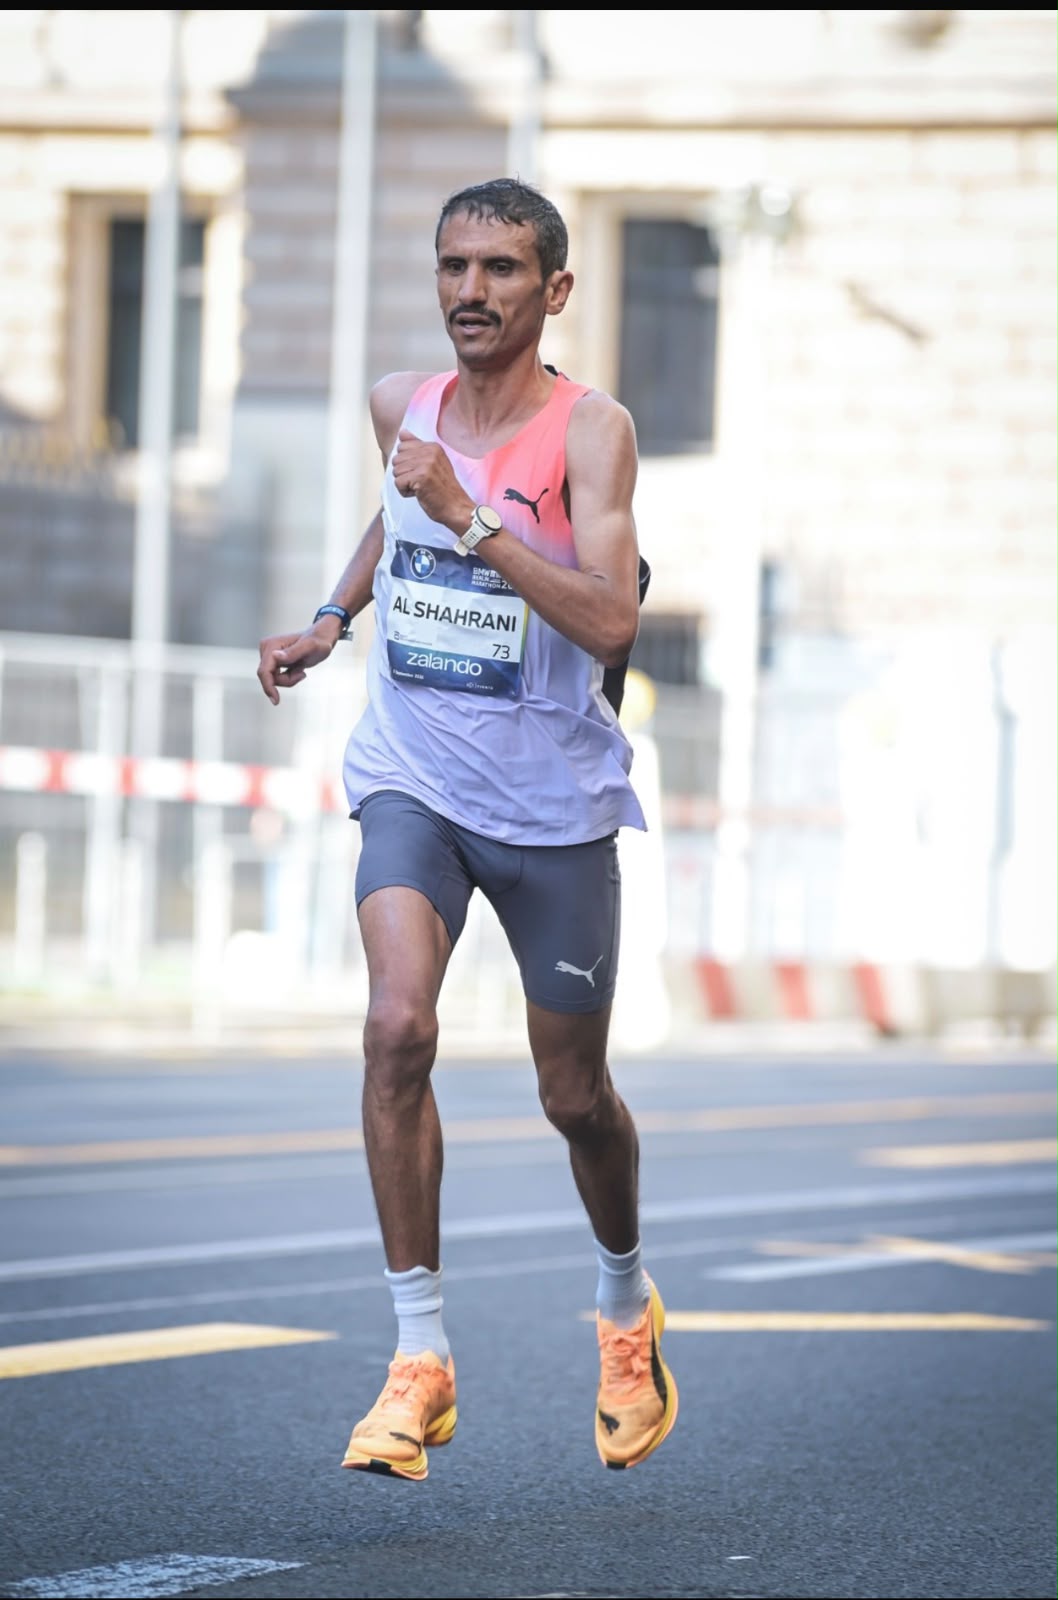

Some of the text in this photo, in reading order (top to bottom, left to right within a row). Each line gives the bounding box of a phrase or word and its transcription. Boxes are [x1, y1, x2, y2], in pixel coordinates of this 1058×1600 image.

[393, 596, 517, 632] AL SHAHRANI
[492, 643, 511, 660] 73
[407, 652, 483, 677] zalando
